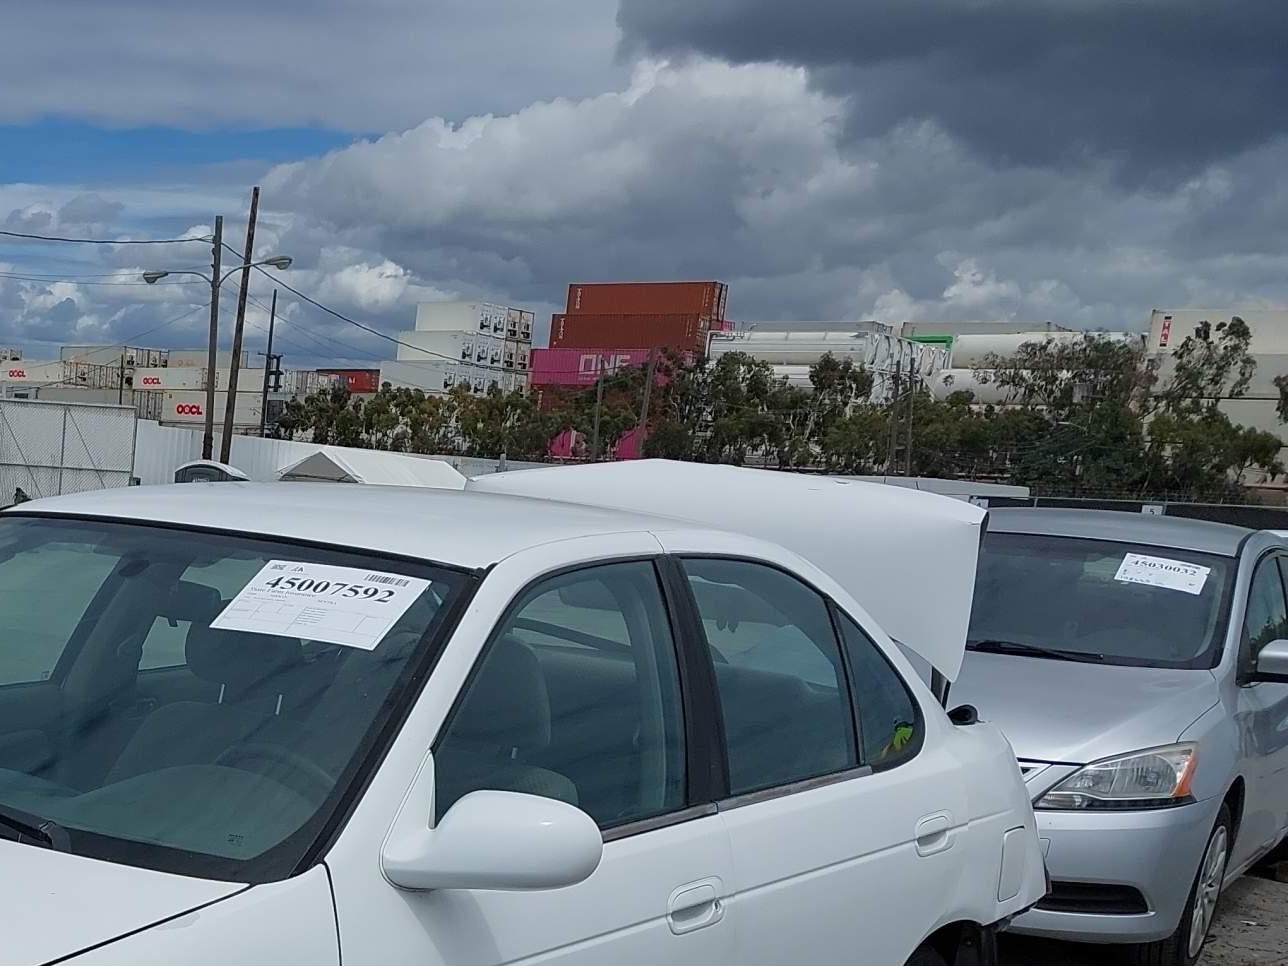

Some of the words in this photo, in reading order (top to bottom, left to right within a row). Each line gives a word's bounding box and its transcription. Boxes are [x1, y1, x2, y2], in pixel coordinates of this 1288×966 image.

[578, 354, 630, 376] ONE
[9, 370, 26, 378] OOCL
[143, 377, 161, 385] OOCL
[176, 404, 202, 415] OOCL
[265, 575, 395, 603] 45007592
